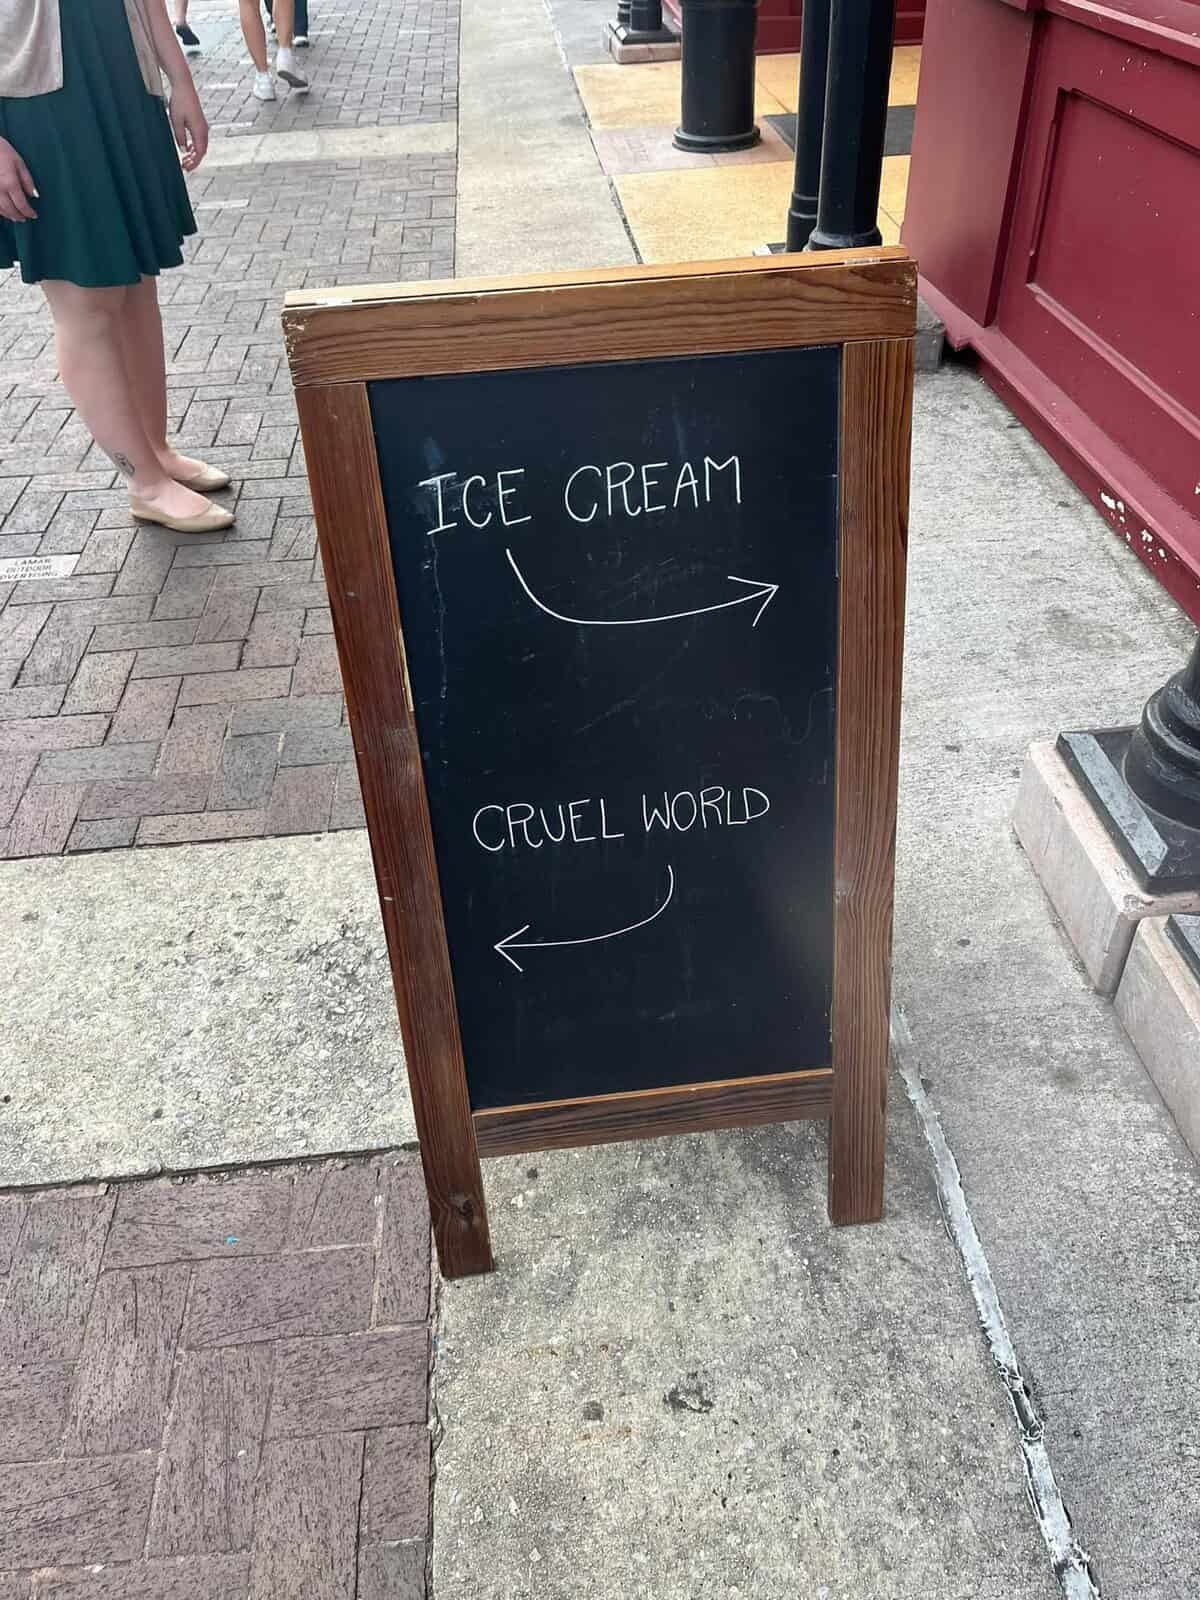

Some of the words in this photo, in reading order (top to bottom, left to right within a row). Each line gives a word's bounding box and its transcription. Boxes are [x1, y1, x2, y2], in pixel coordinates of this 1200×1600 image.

[418, 468, 532, 536] ICE
[564, 455, 742, 523] CREAM
[472, 798, 625, 852] CRUEL
[642, 786, 770, 833] WORLD
